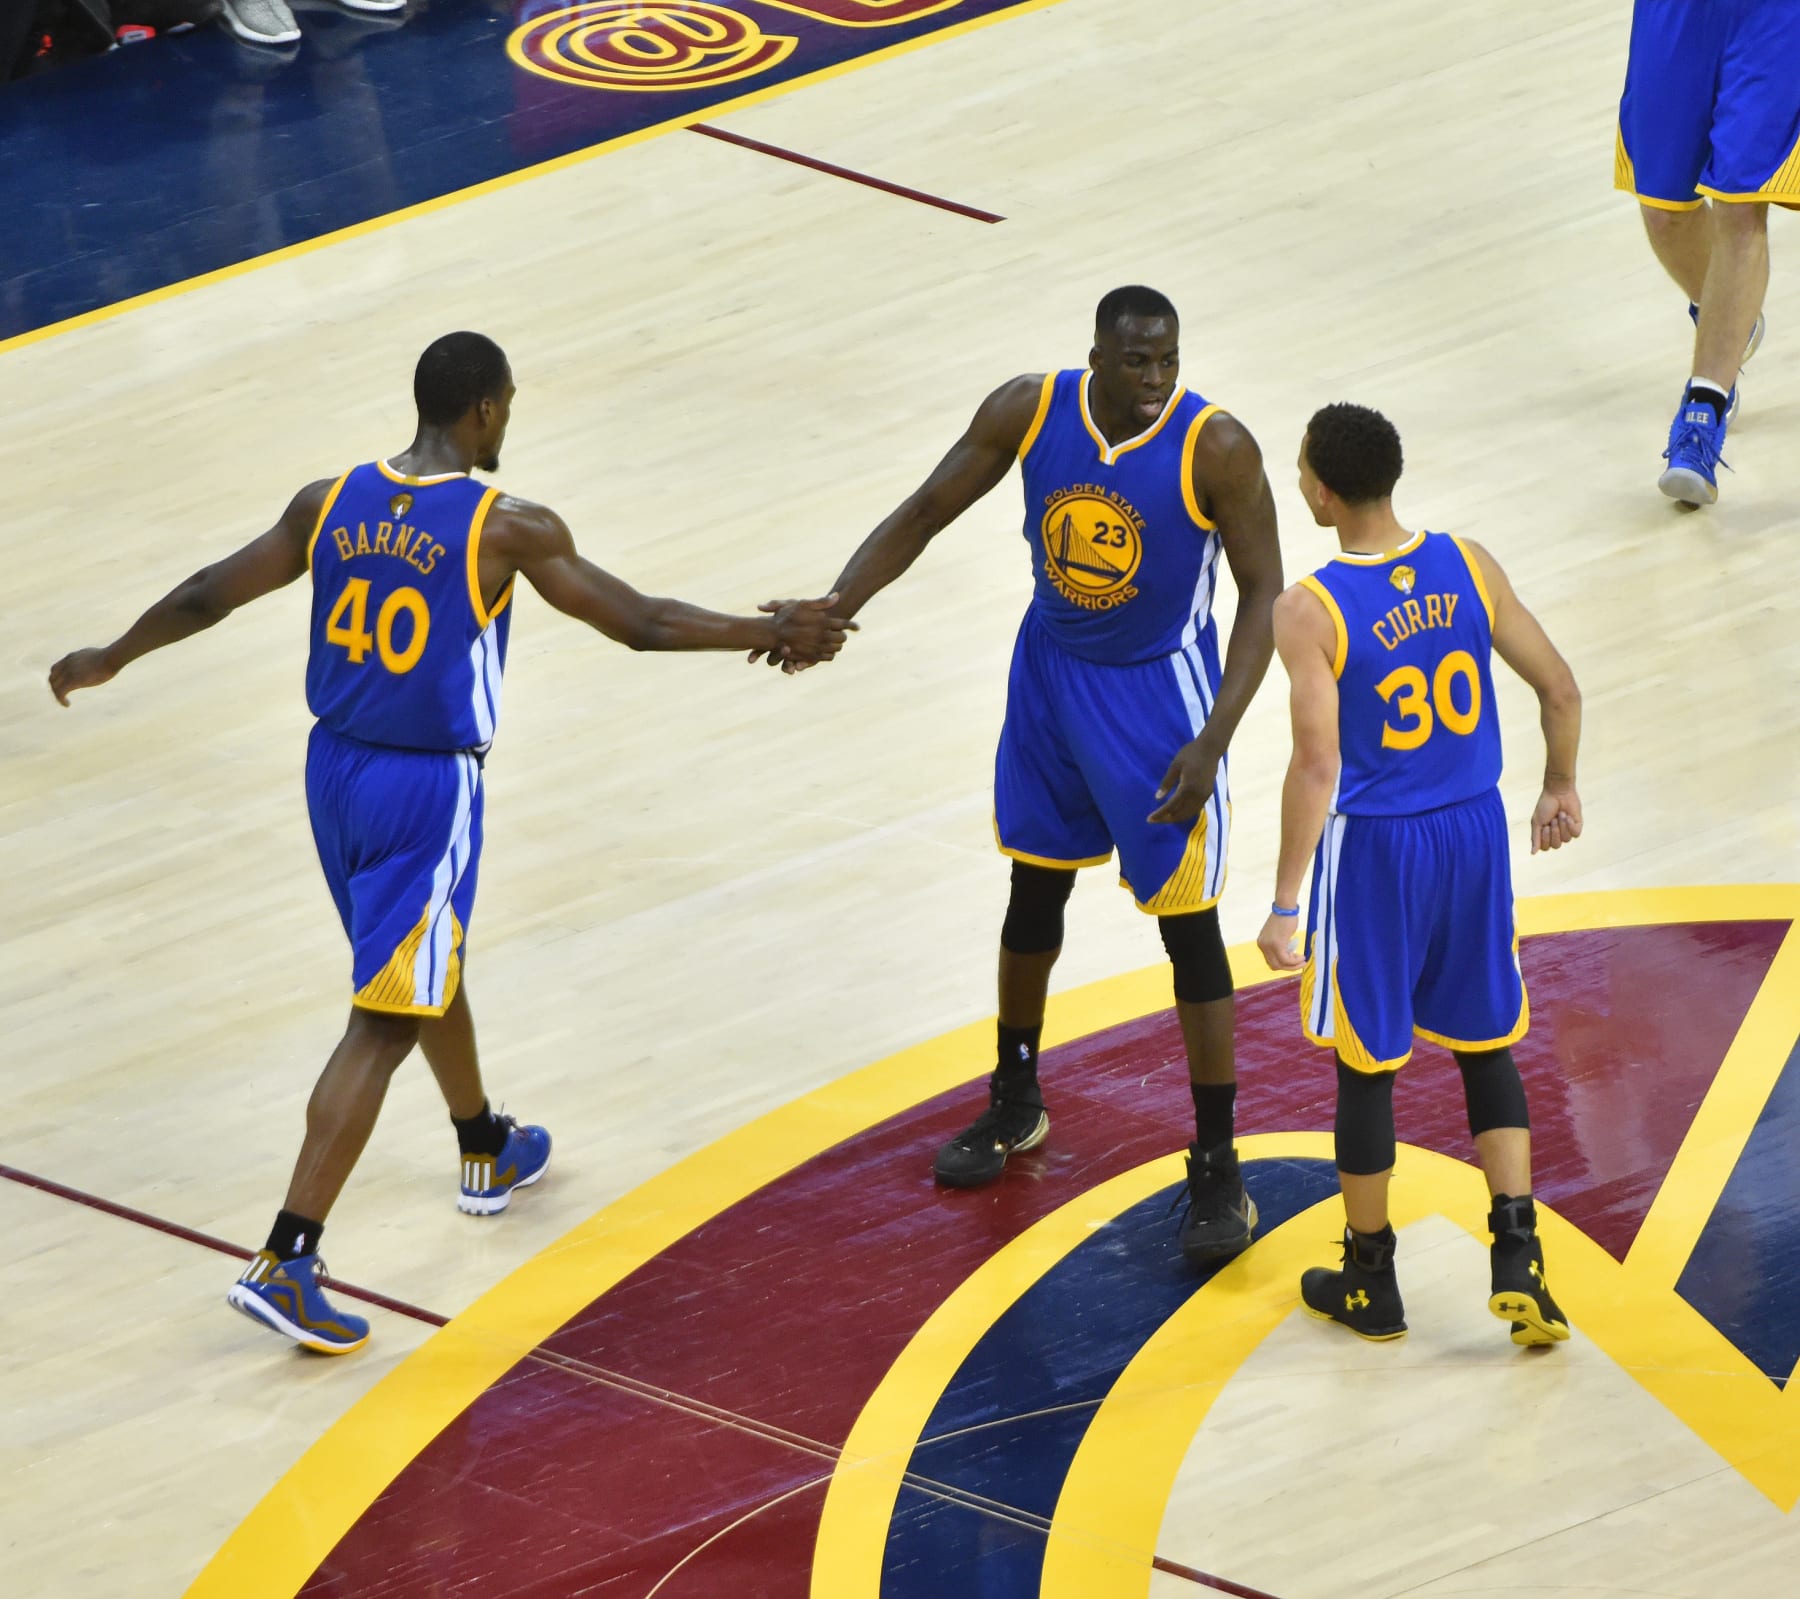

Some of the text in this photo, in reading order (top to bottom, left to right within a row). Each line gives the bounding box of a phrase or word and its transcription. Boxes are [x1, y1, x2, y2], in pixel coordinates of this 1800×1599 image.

[1044, 483, 1147, 530] GOLDEN STATE
[332, 521, 446, 575] BARNES
[1092, 521, 1127, 549] 23
[1044, 560, 1139, 611] WARRIORS
[327, 577, 430, 674] 40
[1372, 593, 1459, 651] CURRY
[1374, 650, 1481, 750] 30
